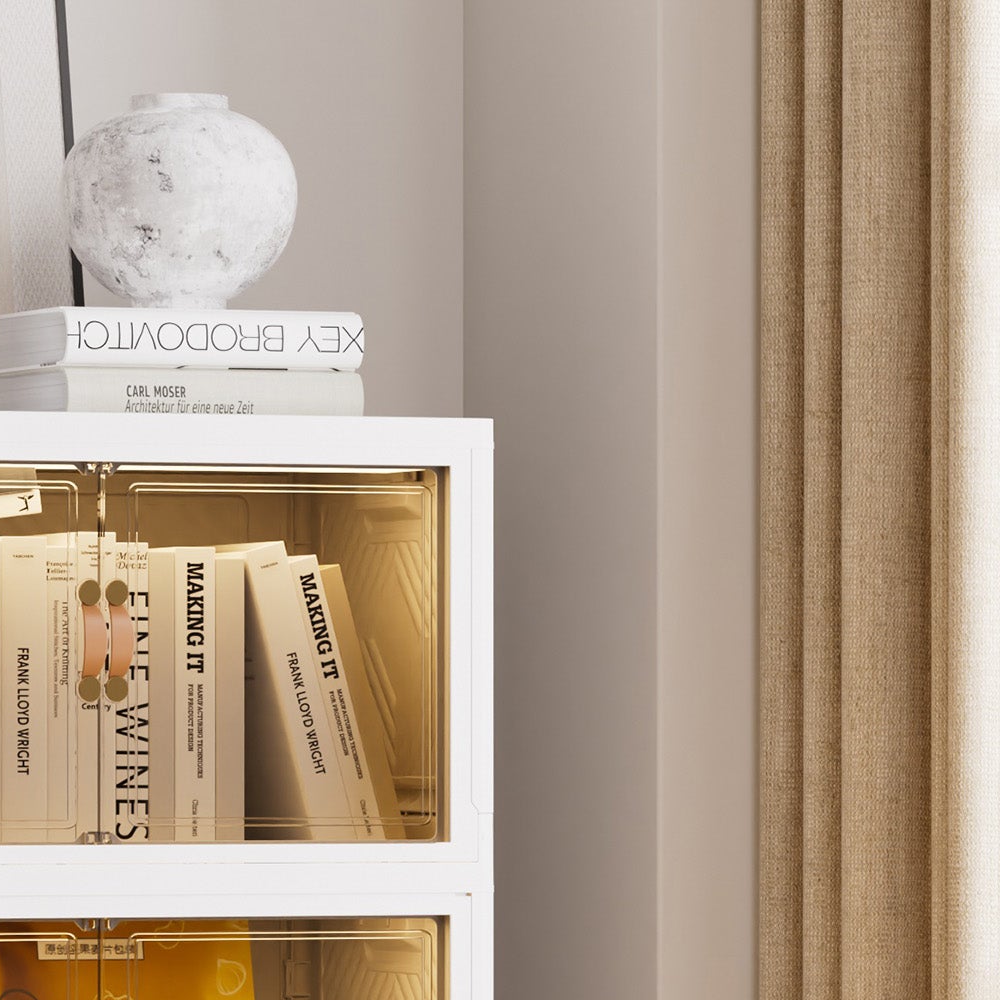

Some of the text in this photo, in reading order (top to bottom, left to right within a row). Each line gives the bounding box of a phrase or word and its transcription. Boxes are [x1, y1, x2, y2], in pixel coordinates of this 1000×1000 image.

[125, 399, 254, 414] Architektur für eine neue Zeit
[126, 385, 187, 398] CARL MOSER
[186, 562, 204, 674] MAKING IT
[300, 572, 339, 680] MAKING IT
[17, 647, 30, 775] FRANK LLOYD WRIGHT
[286, 651, 326, 775] FRANK LLOYD WRIGHT
[328, 690, 337, 702] FOR
[116, 703, 149, 840] WINES
